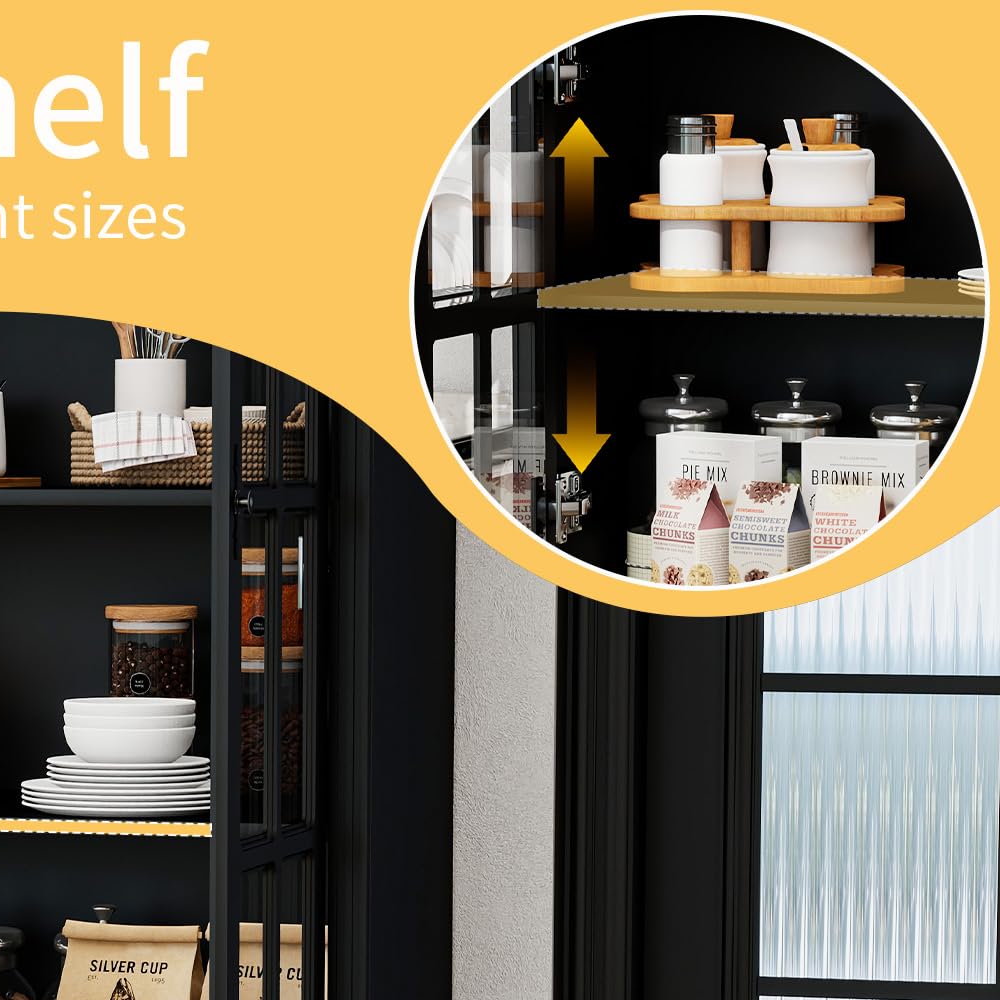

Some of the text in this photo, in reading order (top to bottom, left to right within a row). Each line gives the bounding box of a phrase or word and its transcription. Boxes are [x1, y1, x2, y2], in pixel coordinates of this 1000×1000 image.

[682, 464, 728, 482] PIE MIX
[811, 470, 905, 488] BROWNIE MIX
[656, 510, 680, 519] MILK
[653, 519, 697, 529] CHOCOLATE
[733, 515, 788, 525] SEMISWEET
[815, 518, 857, 527] WHITE
[732, 523, 786, 533] CHOCOLATE
[653, 528, 695, 540] CHUNKS
[731, 532, 785, 544] CHUNKS
[813, 536, 856, 546] CHUN
[90, 959, 168, 975] SILVER CUP
